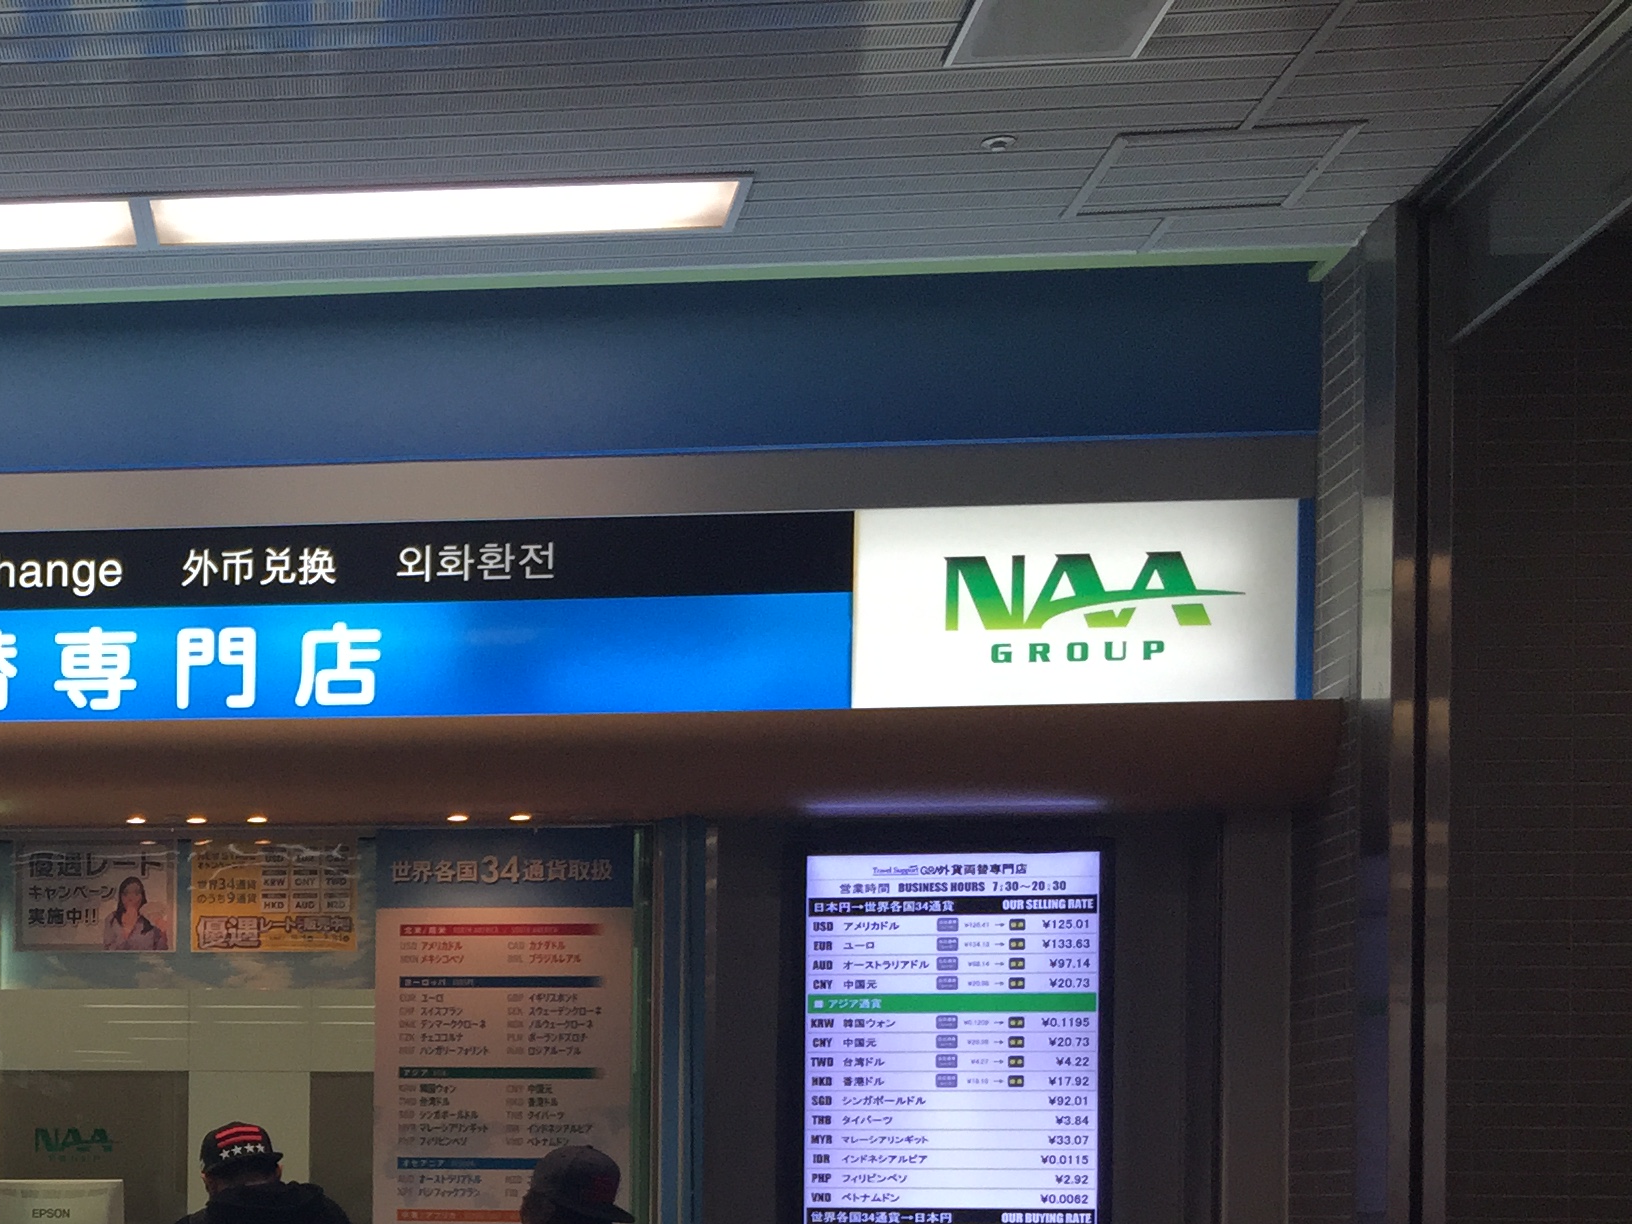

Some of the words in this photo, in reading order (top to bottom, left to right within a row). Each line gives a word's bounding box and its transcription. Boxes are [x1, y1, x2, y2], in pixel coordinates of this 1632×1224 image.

[182, 545, 336, 588] 外币兑换
[396, 542, 556, 584] 외화환전
[944, 551, 1213, 631] NAA
[991, 641, 1165, 663] GROUP
[392, 855, 613, 884] 世界各国34通貨取扱
[839, 883, 890, 894] 営業時間
[898, 881, 948, 893] BUSINESS
[950, 881, 985, 892] HOURS
[1002, 899, 1024, 911] OUR
[1026, 899, 1066, 911] SELLING
[1067, 898, 1094, 910] RATE
[813, 922, 834, 932] USD
[843, 922, 899, 932] アメリカドル
[1042, 919, 1090, 930] ¥125.01
[813, 941, 833, 951] EUR
[843, 941, 875, 951] ユーロ
[1042, 939, 1090, 949] ¥133.63
[812, 960, 833, 970] AUD
[843, 960, 929, 970] オーストラリアドル
[1049, 958, 1090, 969] ¥97.14
[813, 979, 832, 990] CNY
[843, 979, 877, 990] 中国元
[1049, 978, 1090, 988] ¥20.73
[811, 1018, 834, 1028] KRW
[843, 1018, 896, 1028] 韓国ウォン
[1041, 1017, 1090, 1028] ¥0.1195
[812, 1037, 832, 1048] CNY
[843, 1037, 877, 1048] 中国元
[1048, 1037, 1090, 1047] ¥20.73
[811, 1057, 834, 1067] TWD
[843, 1057, 885, 1067] 台湾ドル
[1056, 1057, 1089, 1067] ¥4.22
[811, 1076, 832, 1087] HKD
[843, 1076, 885, 1087] 香港ドル
[1049, 1076, 1089, 1086] ¥17.92
[842, 1096, 926, 1106] シンガポールドル
[1049, 1096, 1088, 1106] ¥92.01
[842, 1115, 893, 1125] タイバーツ
[1056, 1115, 1089, 1126] ¥3.84
[34, 1127, 113, 1153] NAA
[842, 1134, 928, 1145] マレーシアリンギット
[1048, 1135, 1089, 1145] ¥33.07
[842, 1154, 928, 1164] インドネシアルピア
[1041, 1155, 1089, 1165] ¥0.0115
[1056, 1174, 1089, 1185] ¥2.92
[1040, 1194, 1089, 1204] ¥0.0062
[31, 1207, 70, 1219] EPSON
[1001, 1212, 1024, 1224] OUR
[1025, 1213, 1064, 1224] BUYING
[1066, 1213, 1092, 1224] RATE
